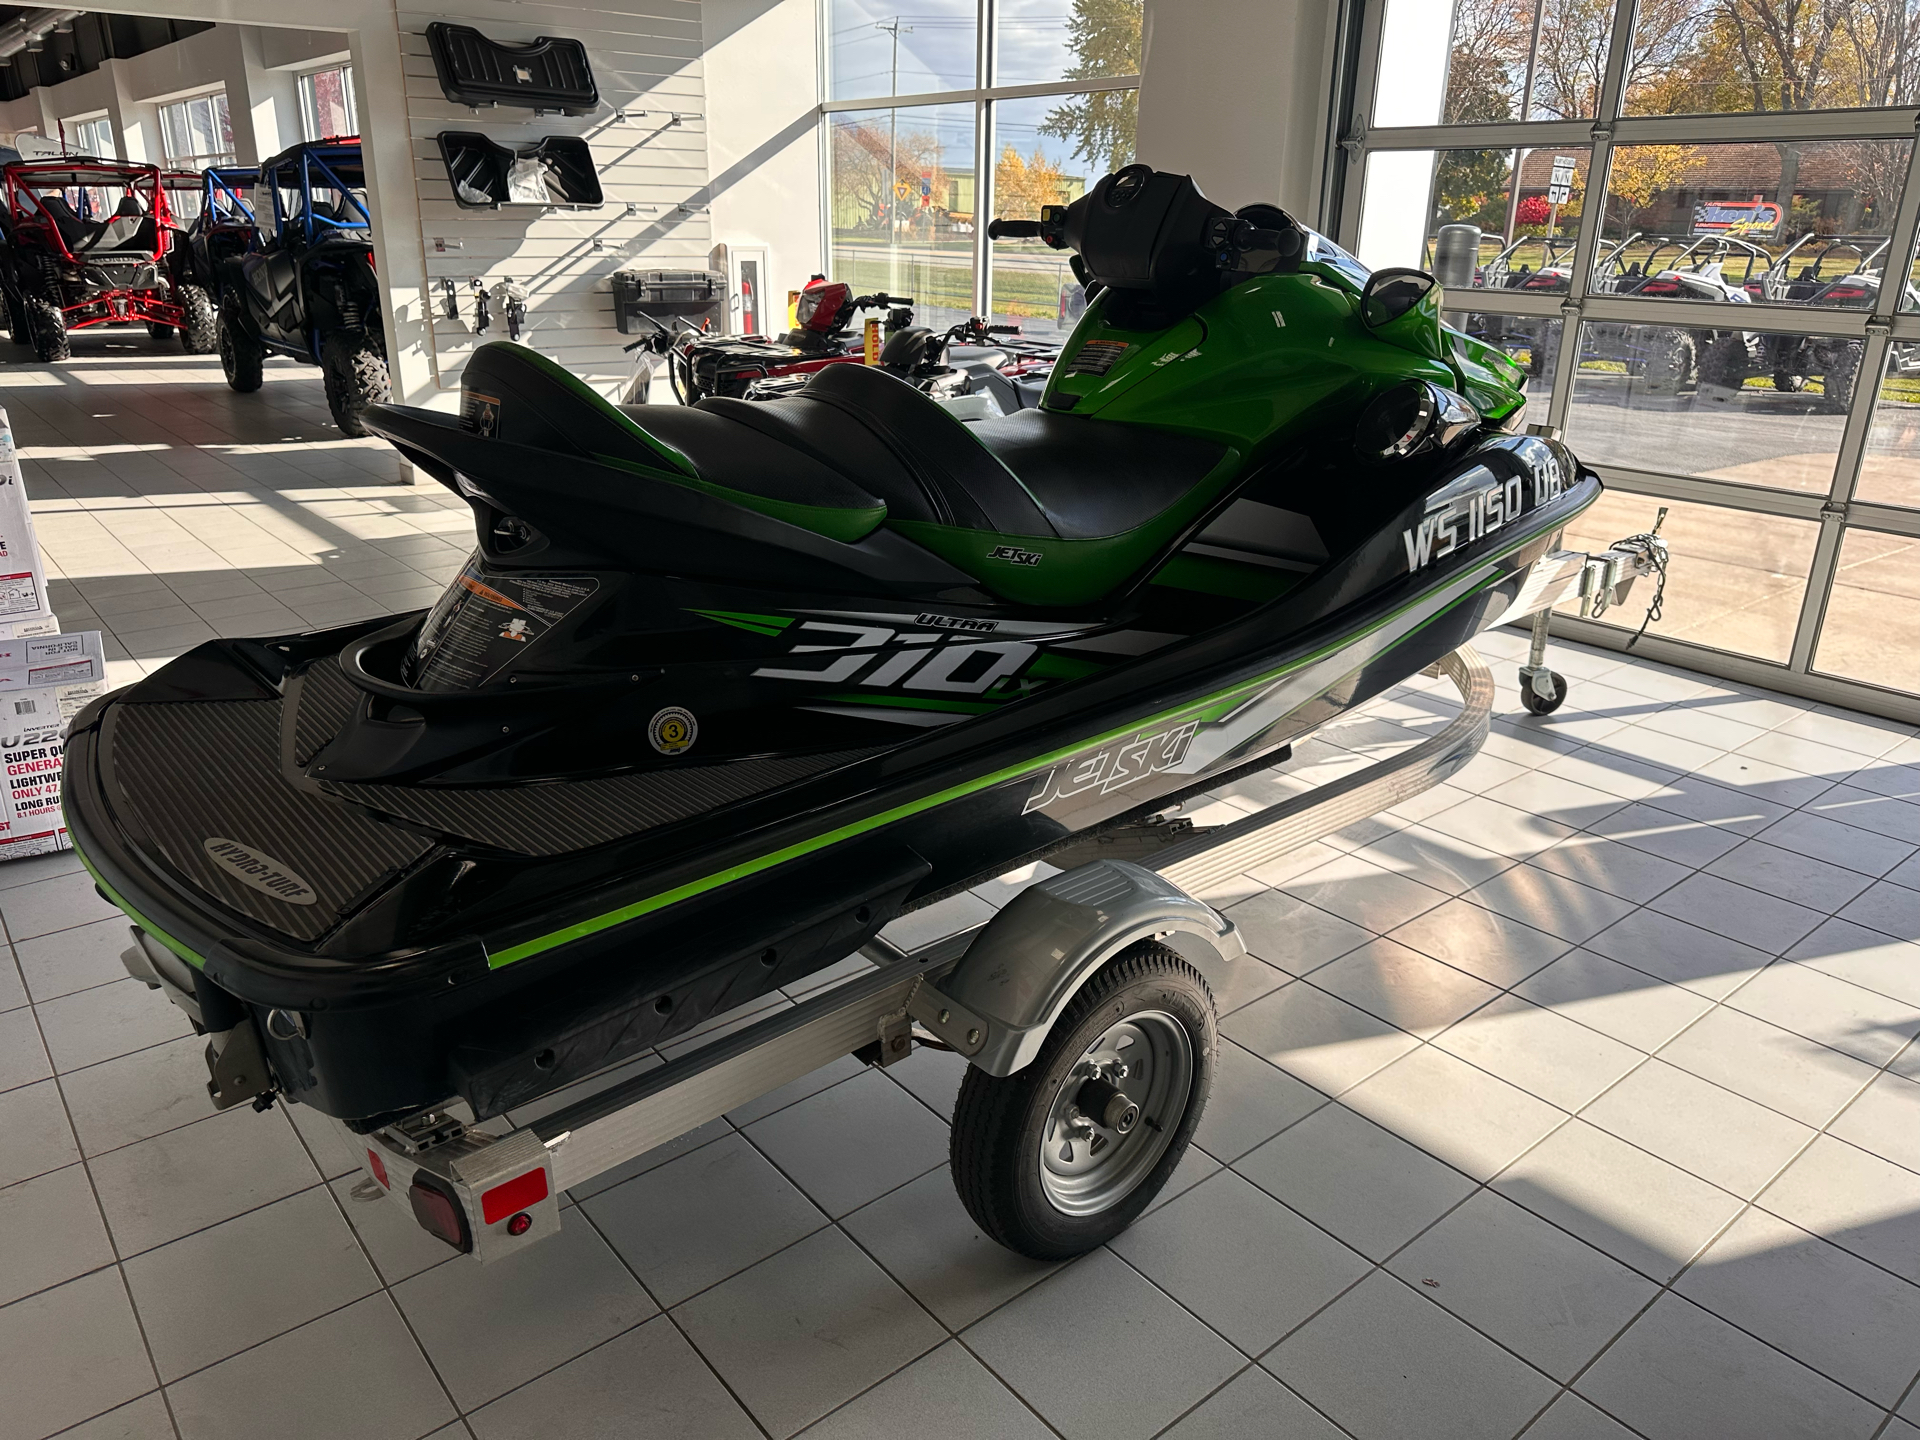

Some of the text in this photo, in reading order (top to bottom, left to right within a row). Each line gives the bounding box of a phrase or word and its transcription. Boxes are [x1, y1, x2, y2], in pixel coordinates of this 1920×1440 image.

[1725, 218, 1776, 236] Sports
[871, 323, 880, 362] HOLD
[1403, 507, 1458, 574] WS
[1469, 474, 1522, 543] 1150
[914, 612, 998, 632] ULTRA
[31, 641, 78, 650] CALIFORNIA
[750, 621, 1038, 694] 310
[668, 724, 679, 739] 3
[4, 744, 64, 764] SUPER QU
[7, 757, 63, 776] GENERA
[10, 771, 61, 790] LIGHTWE
[12, 783, 60, 800] ONLY 47.
[15, 795, 61, 811] LONG RU
[29, 805, 55, 816] HOURS
[0, 821, 11, 831] ST
[209, 842, 310, 898] HYDRO-TURF
